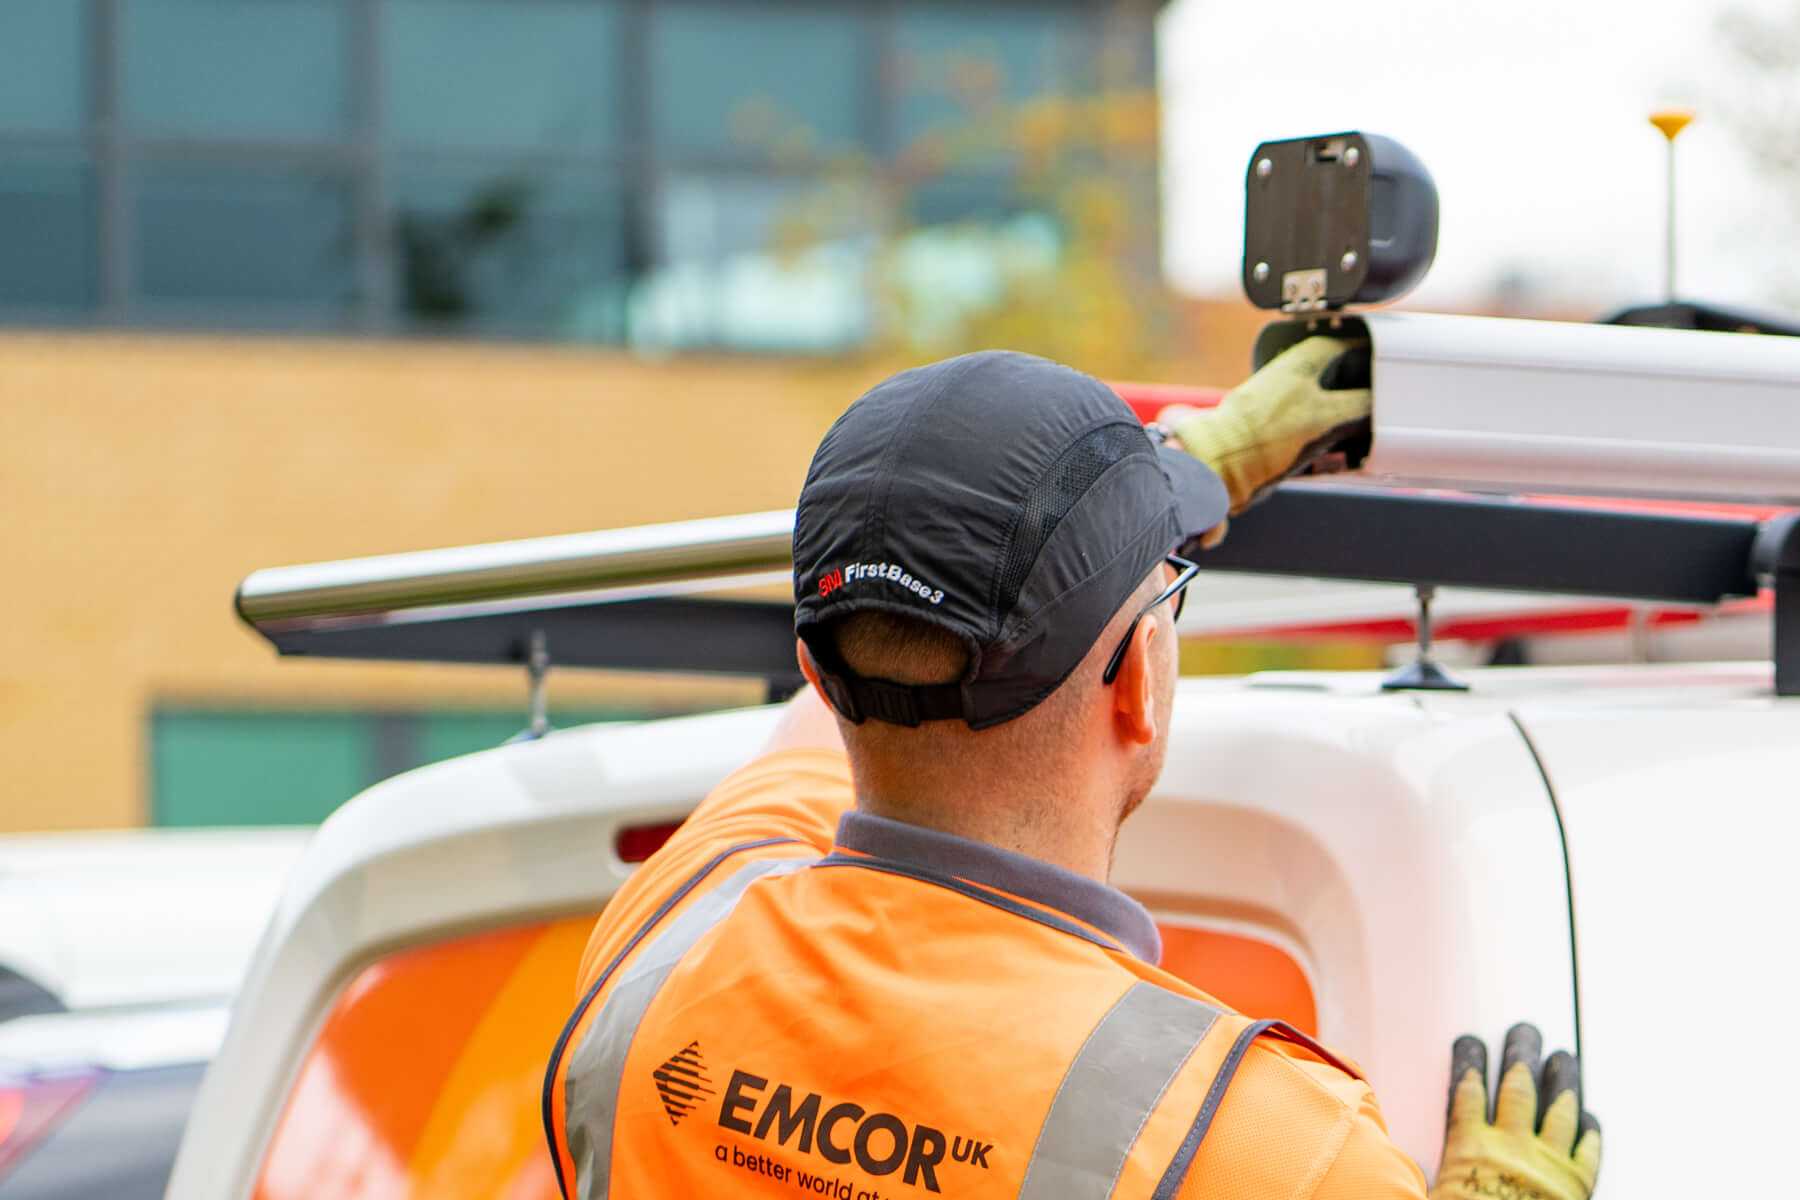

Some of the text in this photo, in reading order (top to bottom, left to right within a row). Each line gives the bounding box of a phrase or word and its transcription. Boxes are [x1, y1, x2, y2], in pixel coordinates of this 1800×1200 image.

[818, 567, 844, 598] 3M
[717, 1068, 994, 1194] EMCOR UK
[714, 1143, 728, 1161] a
[733, 1145, 792, 1183] better
